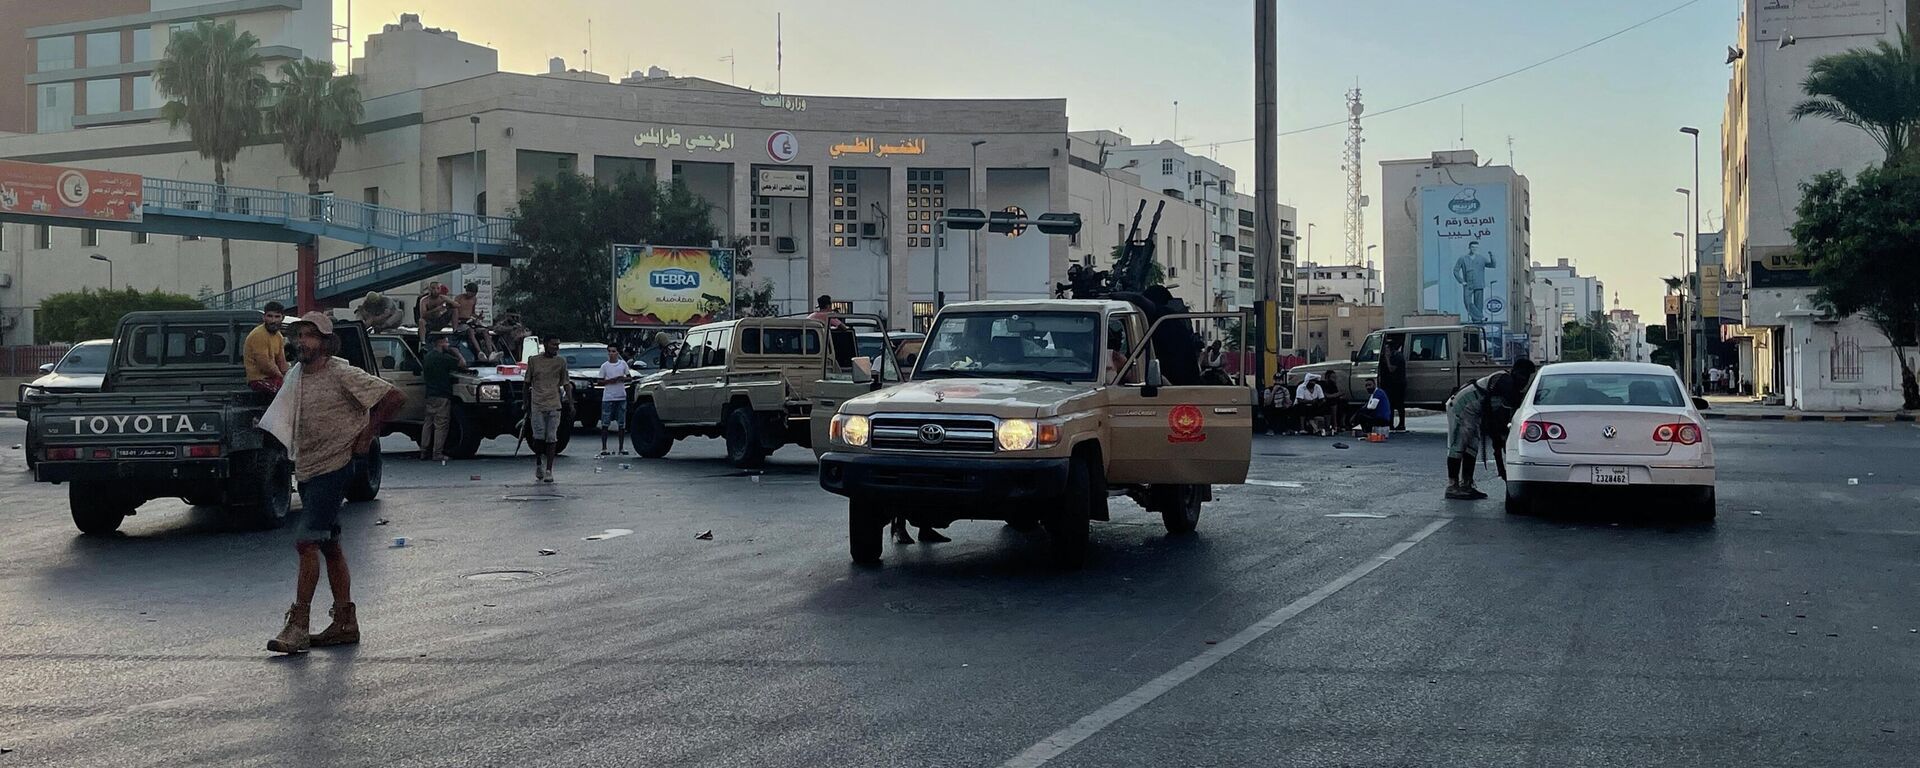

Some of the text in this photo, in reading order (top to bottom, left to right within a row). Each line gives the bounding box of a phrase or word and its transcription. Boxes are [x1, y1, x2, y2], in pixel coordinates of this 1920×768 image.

[784, 97, 807, 111] وزارة
[633, 128, 734, 152] المرجعي طرابلس
[829, 136, 926, 159] المختبر الطبي
[1433, 215, 1495, 228] المرتبة رقم 1
[1474, 229, 1491, 240] في
[652, 273, 696, 285] TEBRA
[70, 414, 194, 435] TOYOTA
